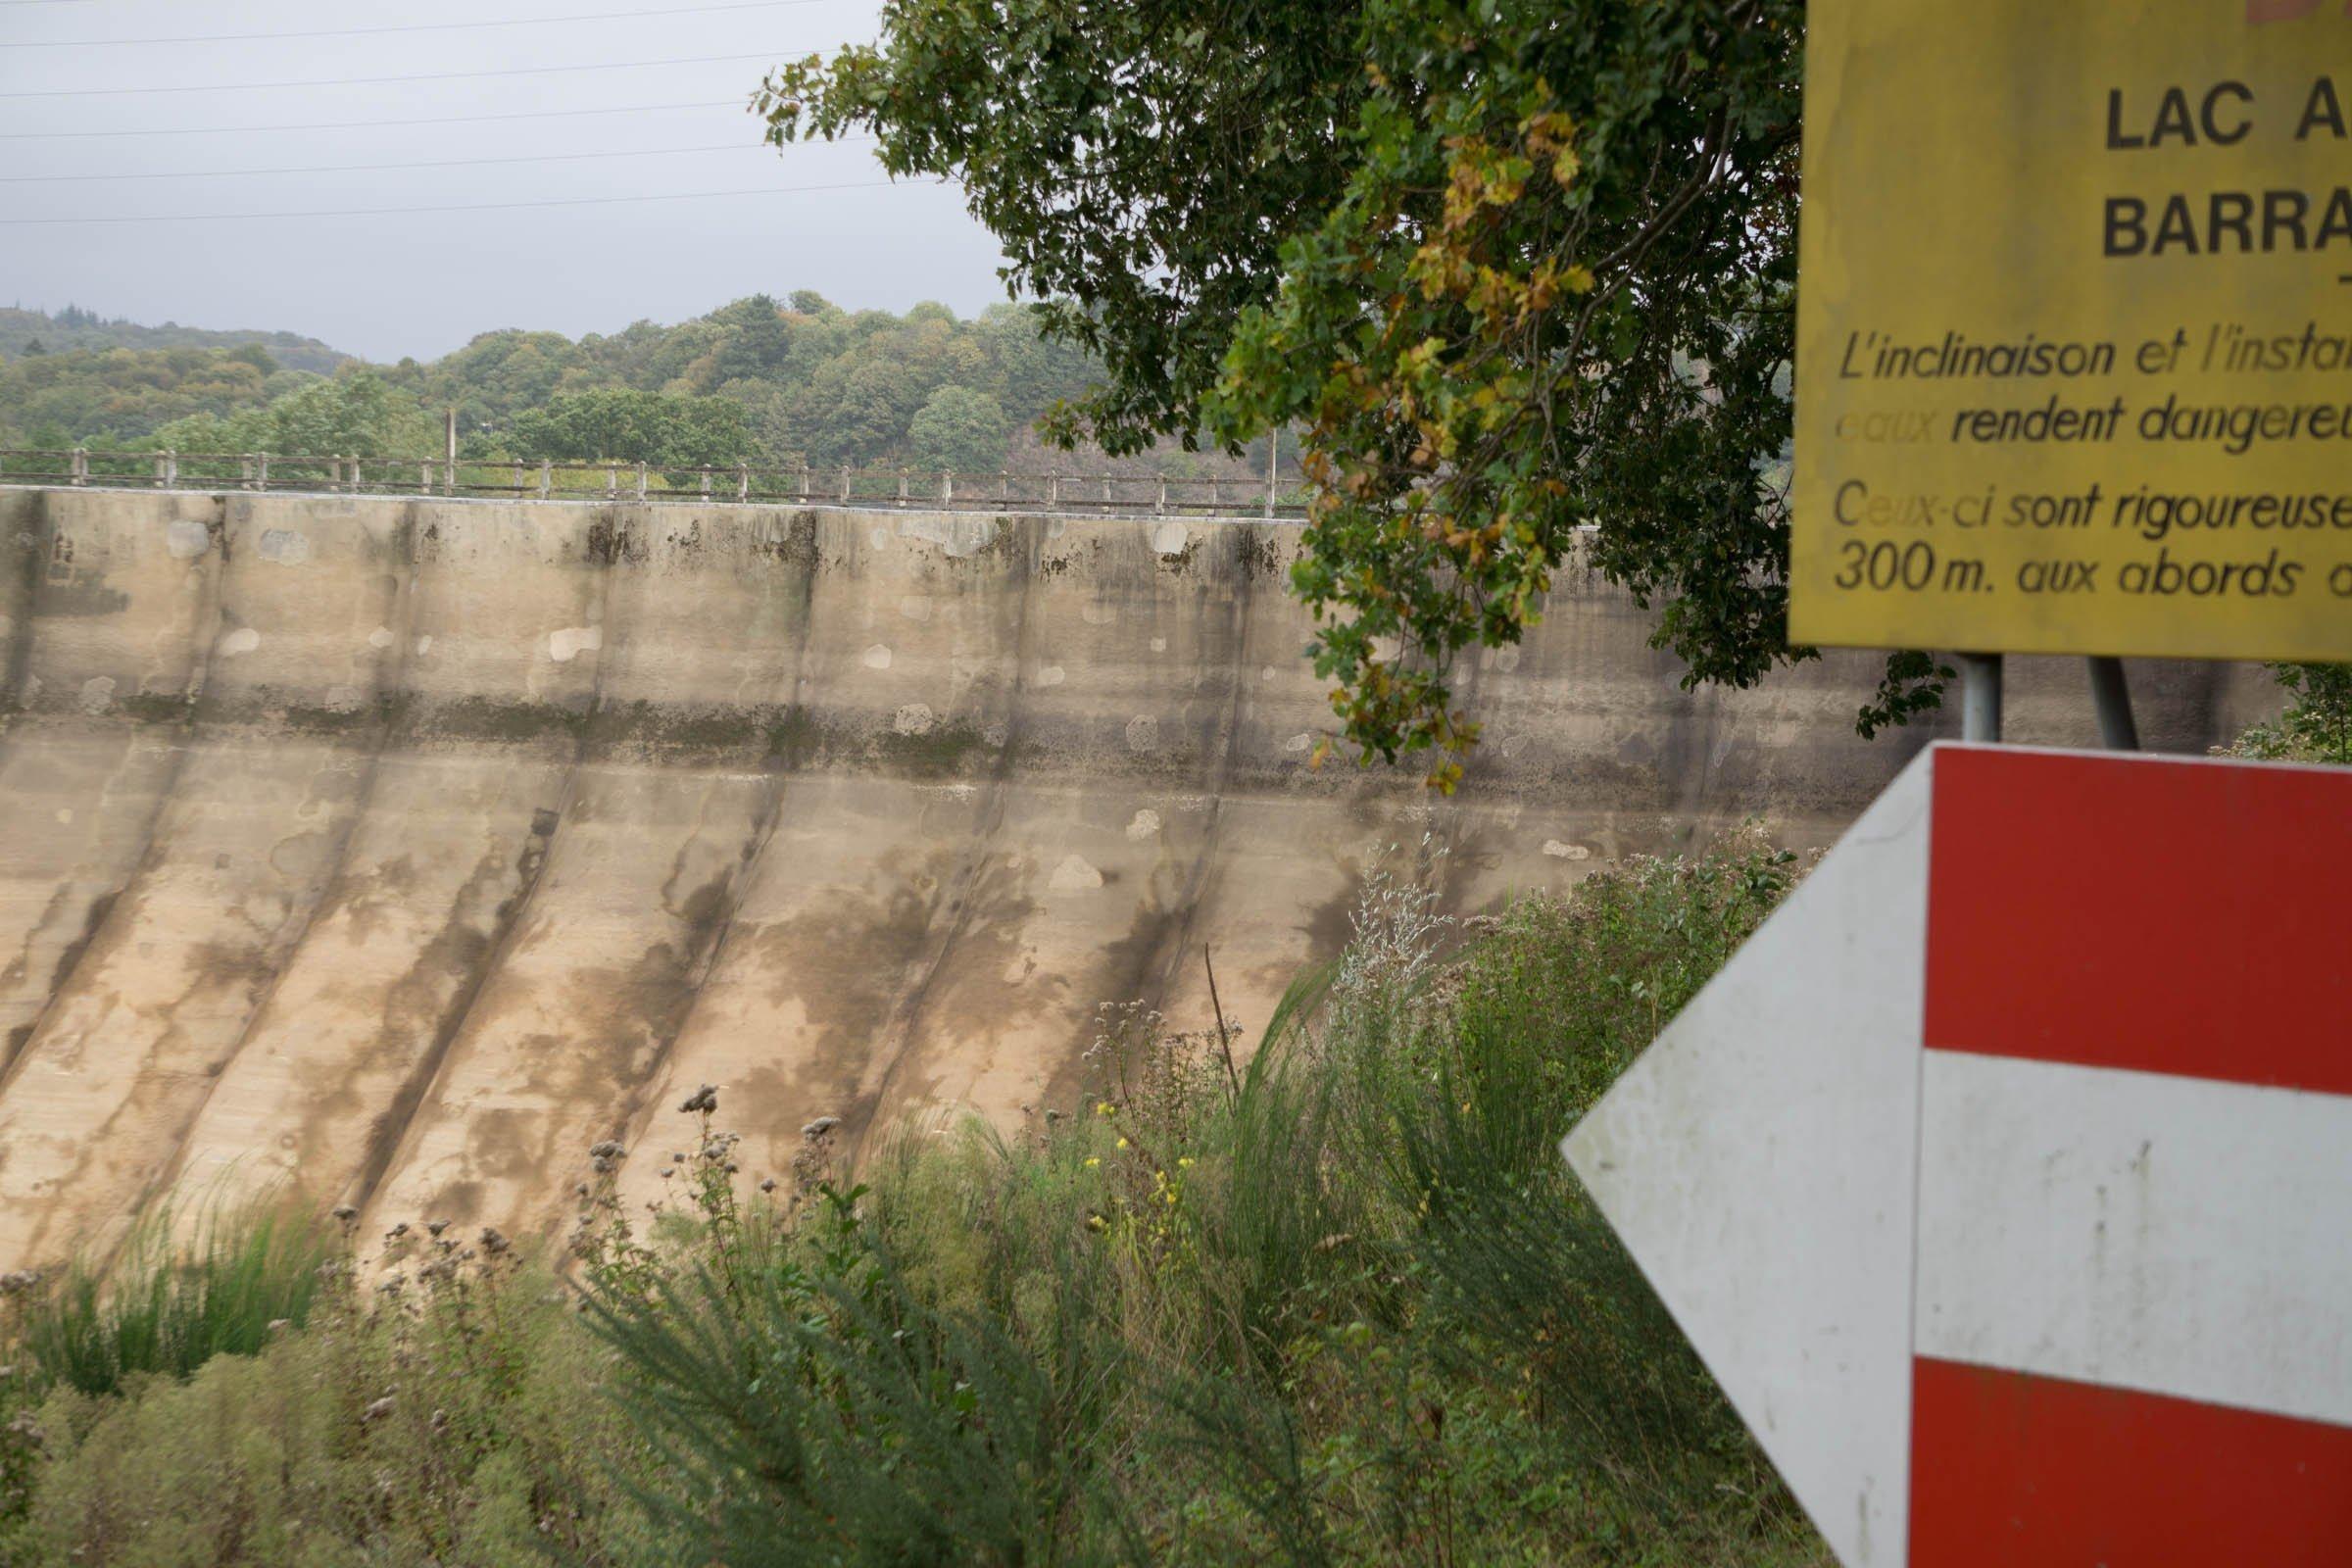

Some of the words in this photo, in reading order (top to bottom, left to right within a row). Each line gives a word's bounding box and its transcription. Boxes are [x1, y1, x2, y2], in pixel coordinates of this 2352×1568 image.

[2106, 81, 2254, 150] LAC
[2103, 186, 2352, 258] BARRA
[1838, 330, 2117, 379] L'inclinaison
[2134, 327, 2187, 374] et
[1950, 394, 2127, 443] rendent
[1833, 478, 1996, 529] Ceux-ci
[2002, 482, 2103, 529] sont
[2111, 484, 2352, 541] rigoureuse
[2016, 561, 2100, 594] aux
[2117, 547, 2305, 597] abords
